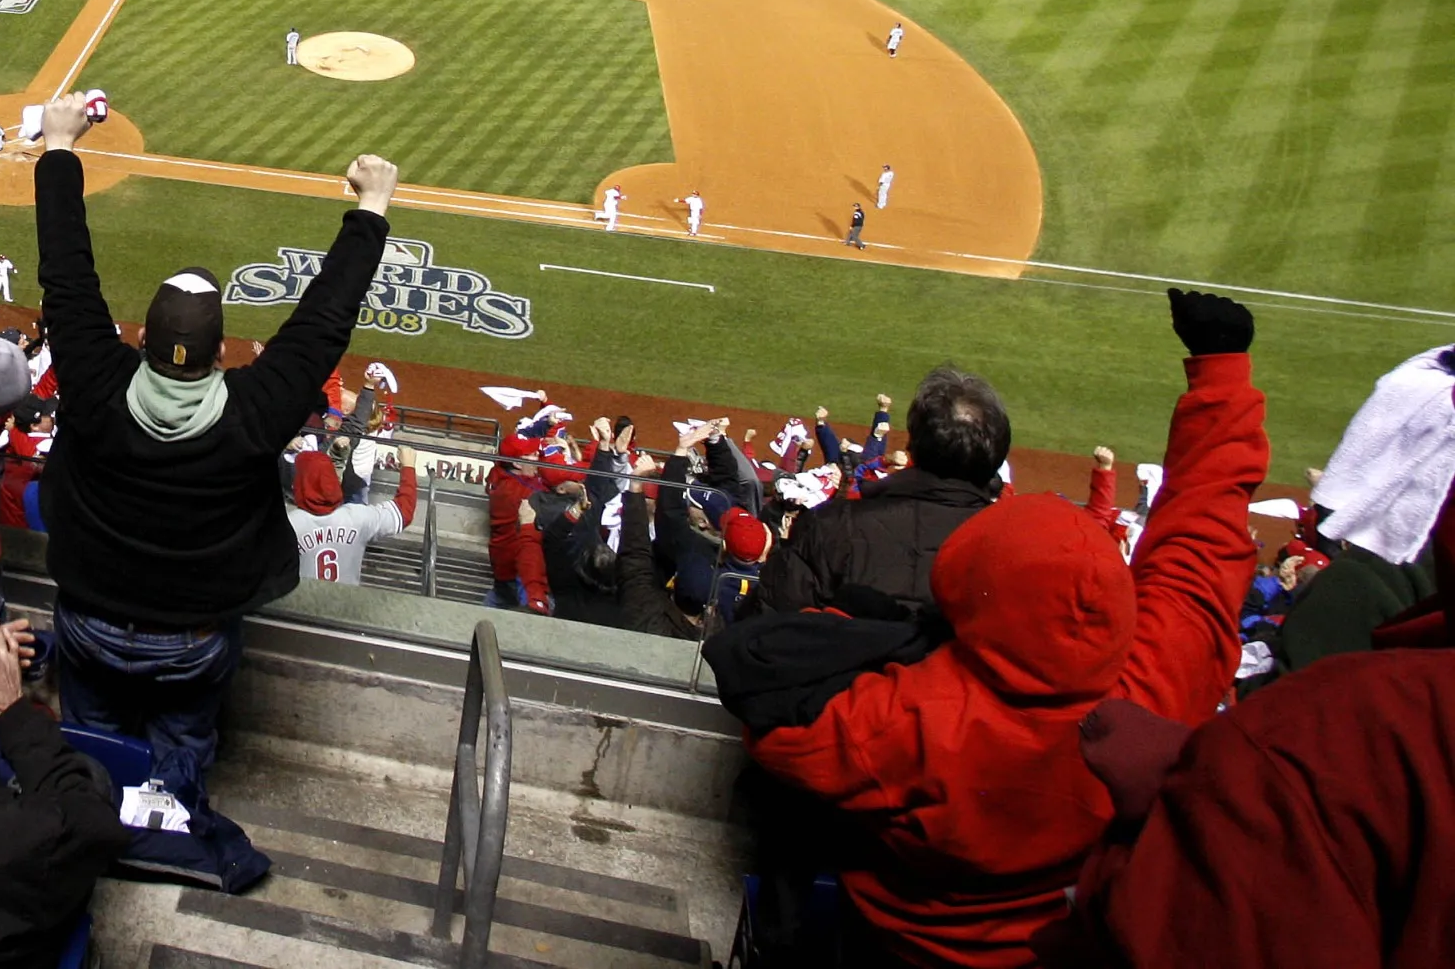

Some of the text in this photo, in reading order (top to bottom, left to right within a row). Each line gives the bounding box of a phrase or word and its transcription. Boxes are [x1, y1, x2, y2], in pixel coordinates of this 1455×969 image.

[286, 251, 484, 294] WRLD
[355, 307, 423, 332] 008
[316, 548, 339, 583] 6
